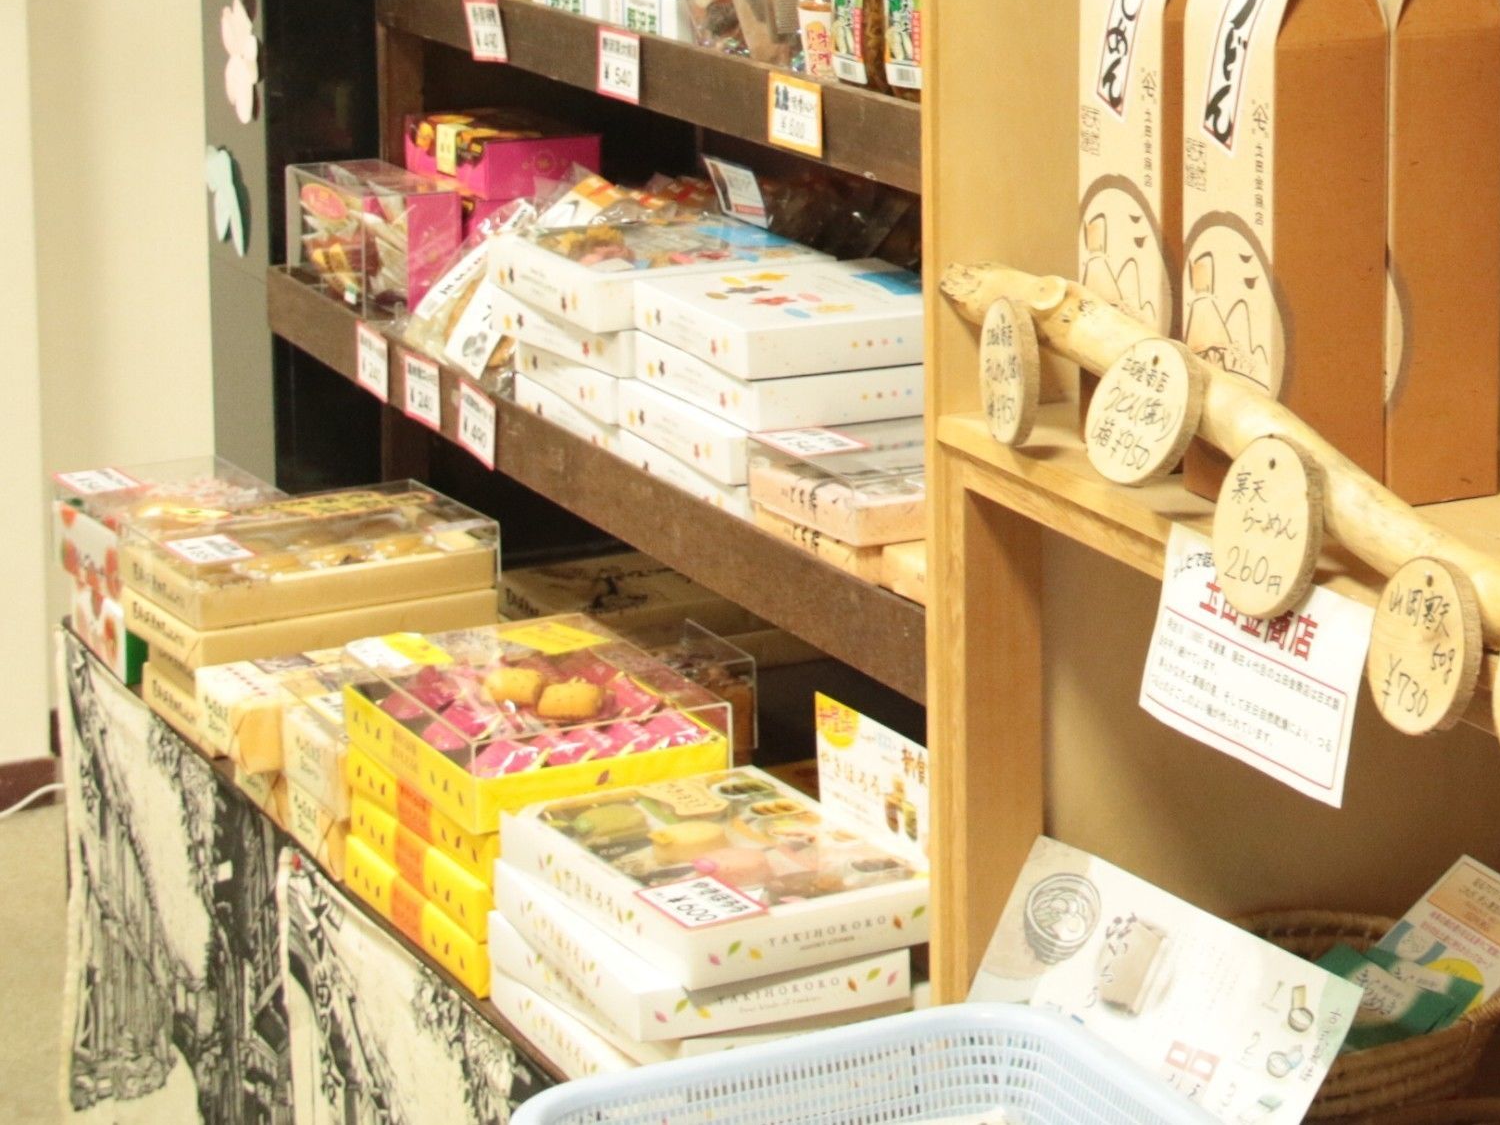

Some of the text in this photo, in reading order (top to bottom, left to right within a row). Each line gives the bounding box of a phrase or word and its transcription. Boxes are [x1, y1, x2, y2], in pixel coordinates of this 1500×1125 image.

[1231, 467, 1269, 504] 寒天
[1224, 545, 1283, 595] 260円
[1381, 653, 1430, 718] ¥730
